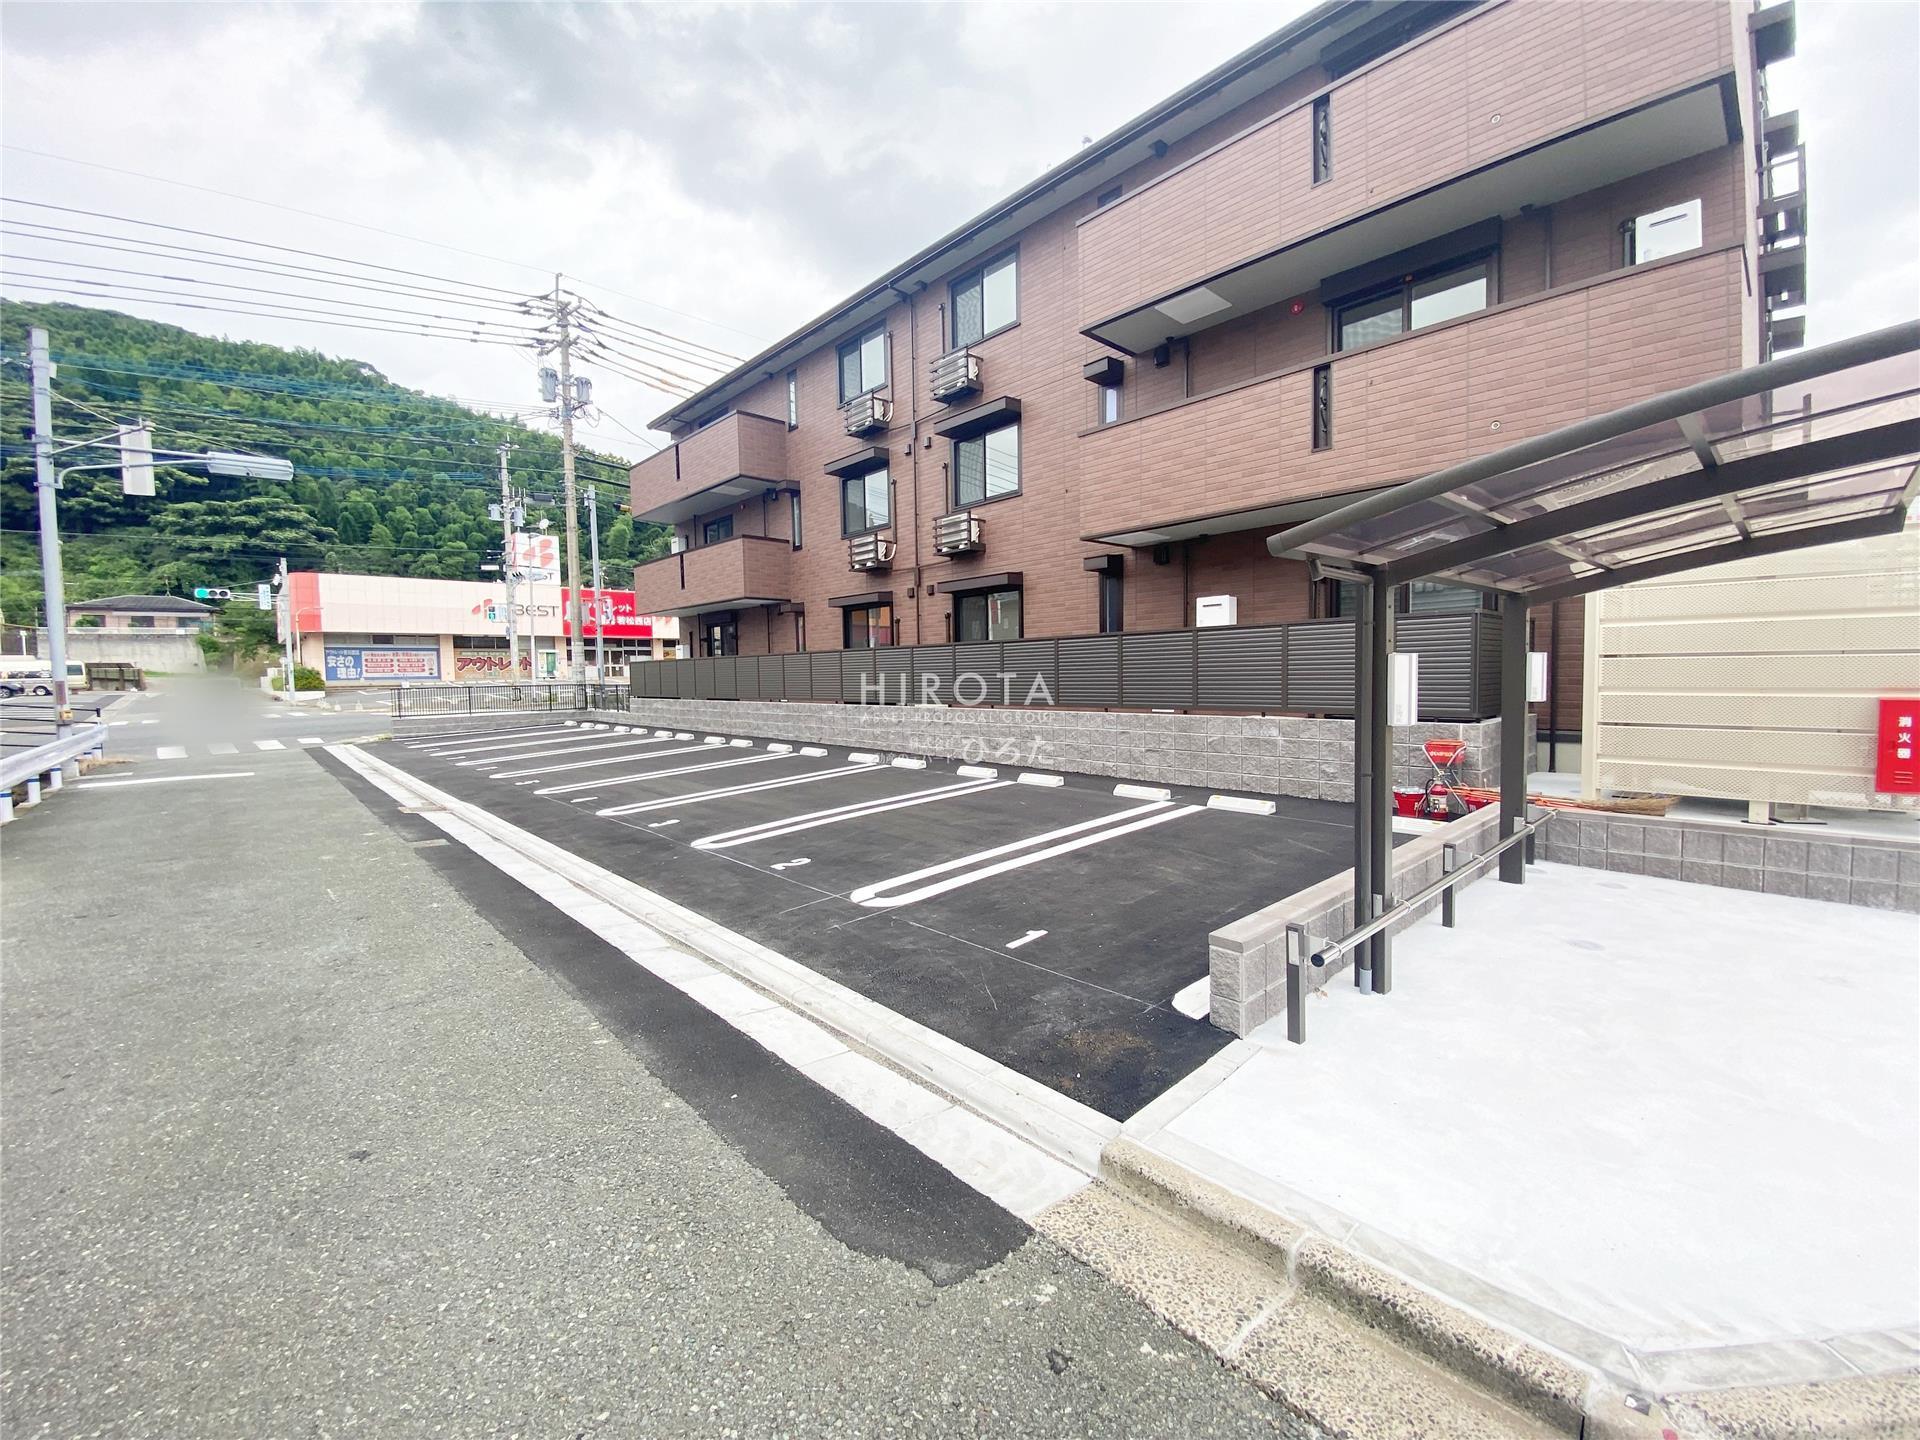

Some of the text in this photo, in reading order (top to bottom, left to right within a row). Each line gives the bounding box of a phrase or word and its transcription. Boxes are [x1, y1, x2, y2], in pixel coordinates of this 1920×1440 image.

[327, 655, 355, 668] 安さの
[456, 656, 533, 671] アウトレト
[770, 856, 812, 872] 2
[1005, 929, 1049, 950] 1
